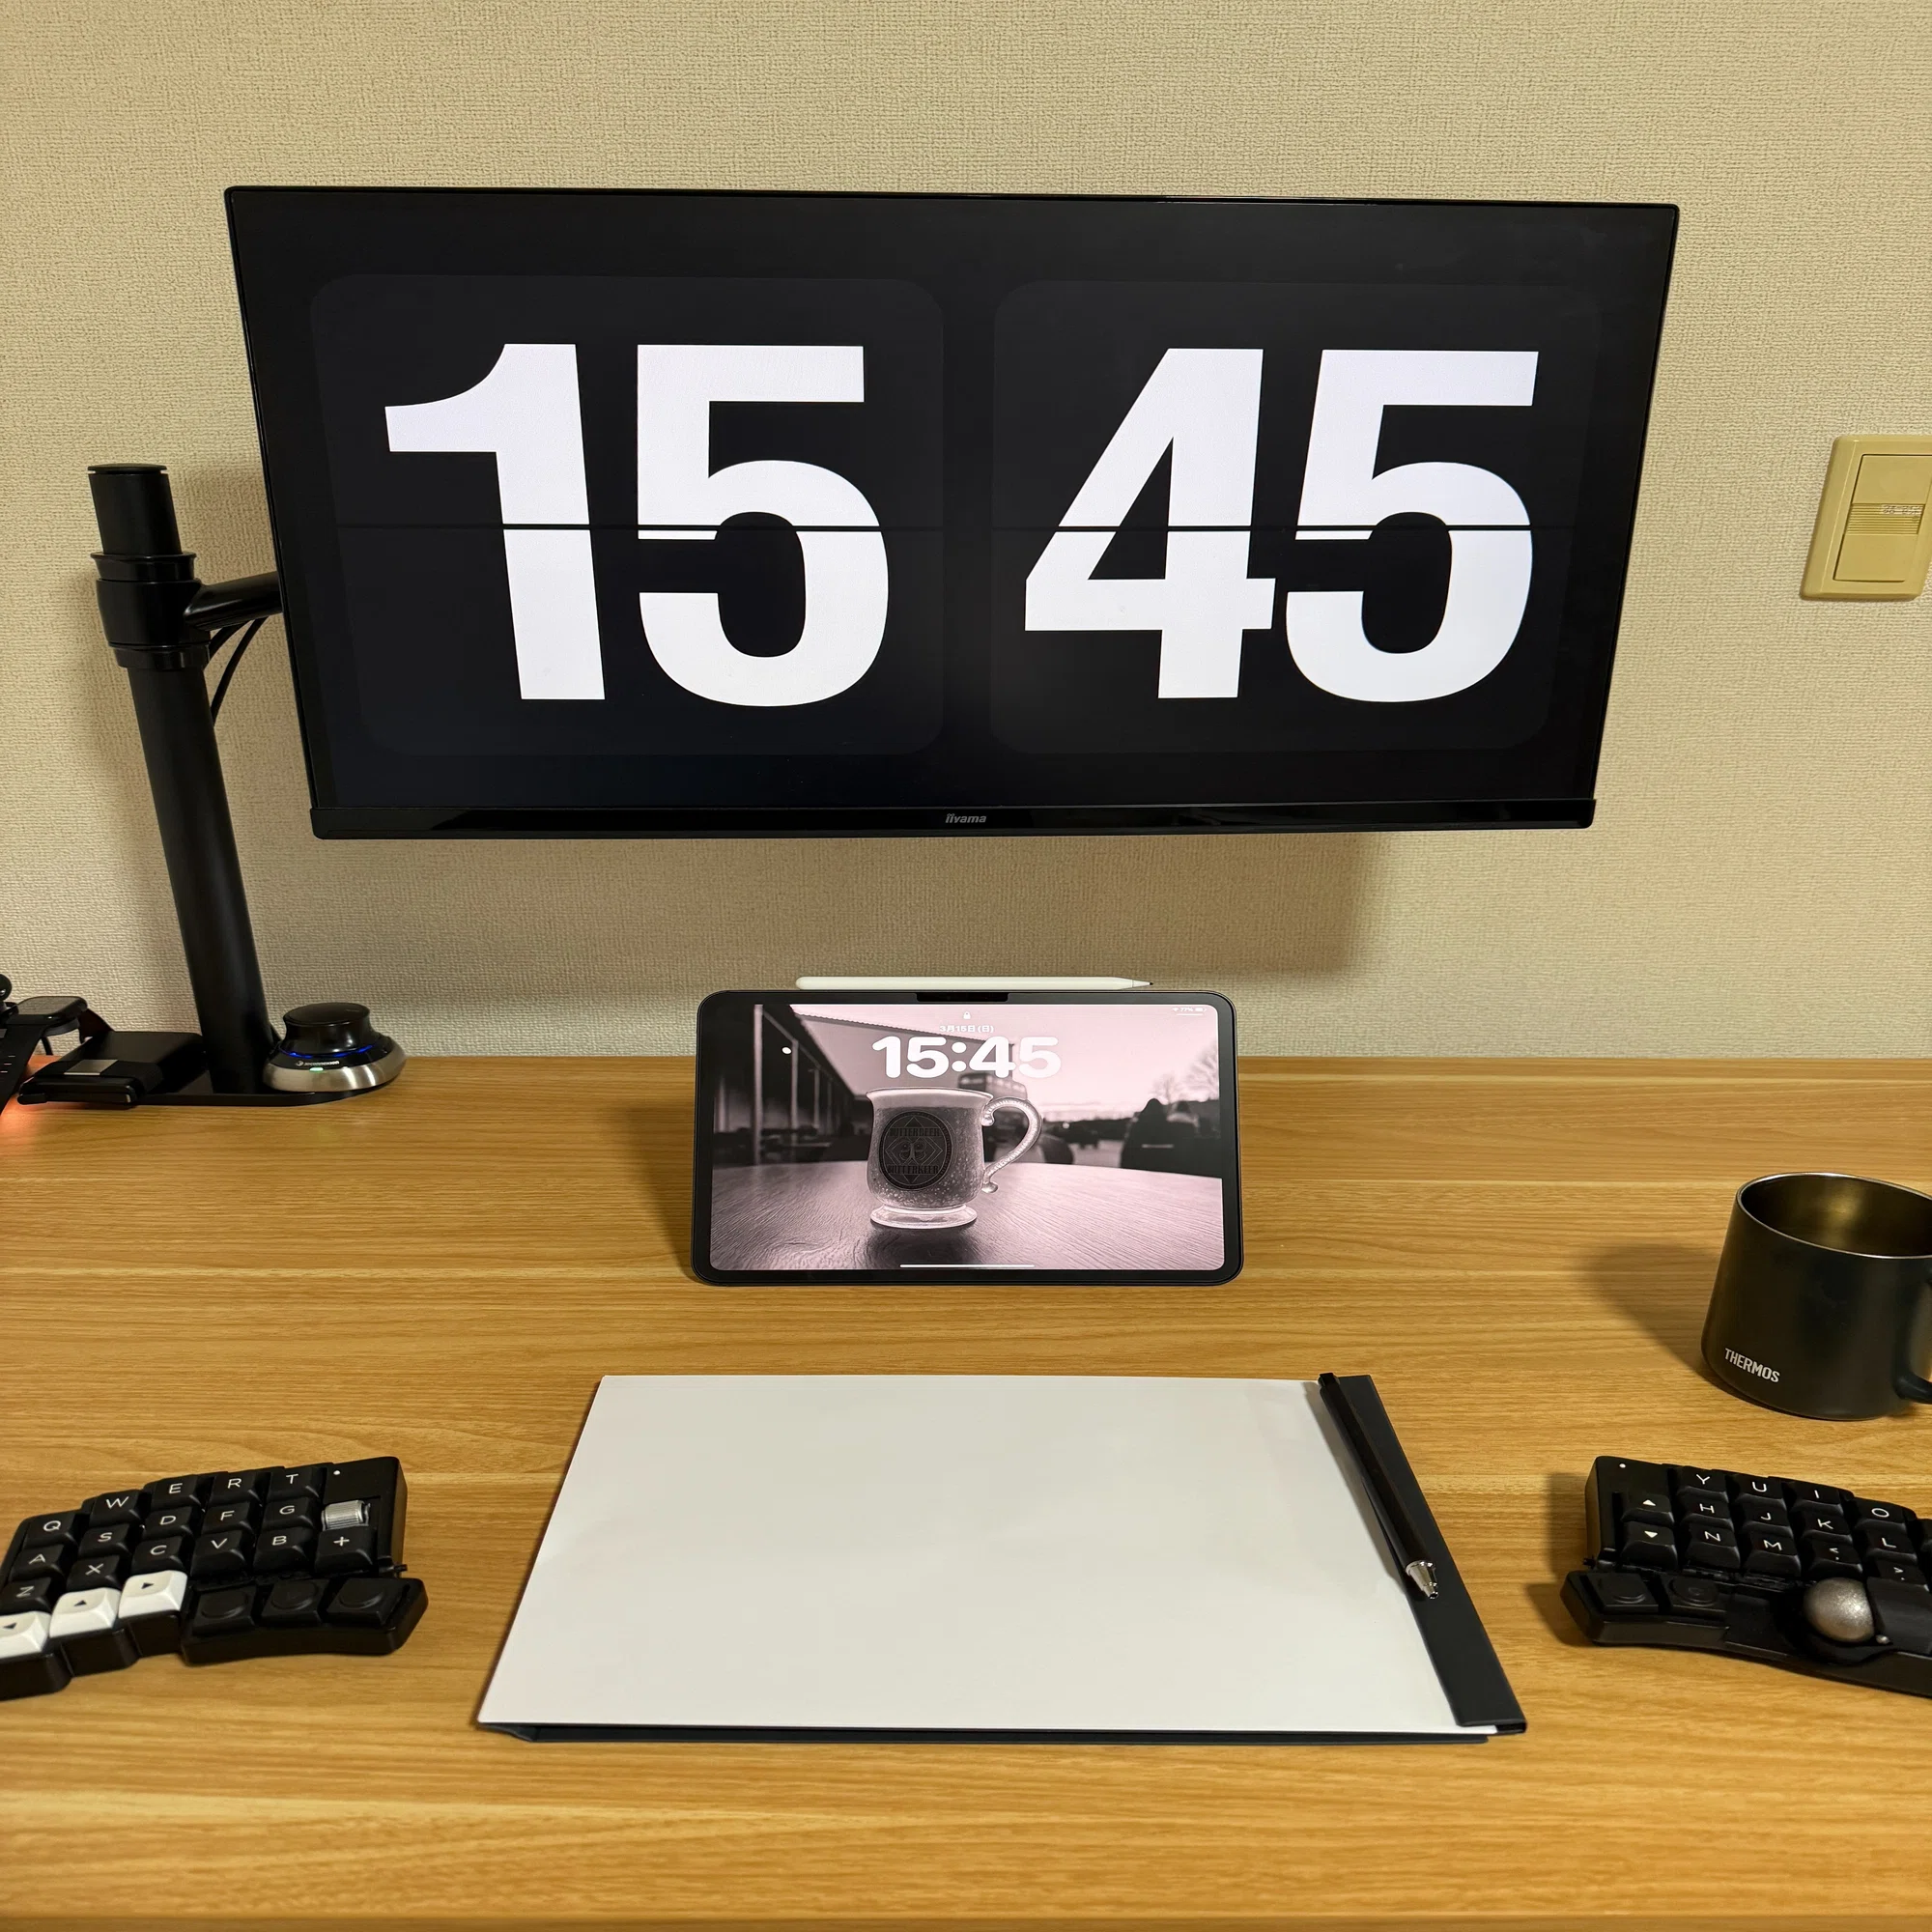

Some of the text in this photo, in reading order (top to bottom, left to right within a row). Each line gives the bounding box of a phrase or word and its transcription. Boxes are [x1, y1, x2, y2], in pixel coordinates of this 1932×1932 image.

[385, 343, 1539, 707] 15 45
[945, 813, 986, 823] iiyama
[872, 1036, 1062, 1079] 15:45
[1724, 1348, 1780, 1382] THERMOS
[43, 1473, 299, 1532] Q W E R T
[1695, 1473, 1711, 1485] Y
[1751, 1481, 1768, 1492] U
[1871, 1507, 1889, 1518] O
[29, 1505, 296, 1564] A S D F G
[1699, 1503, 1897, 1548] H J K L
[1704, 1530, 1721, 1542] N
[1763, 1539, 1782, 1551] M
[16, 1585, 34, 1598] Z
[86, 1563, 104, 1575] X
[150, 1545, 167, 1555] C
[211, 1538, 228, 1549] V
[271, 1535, 287, 1546] B
